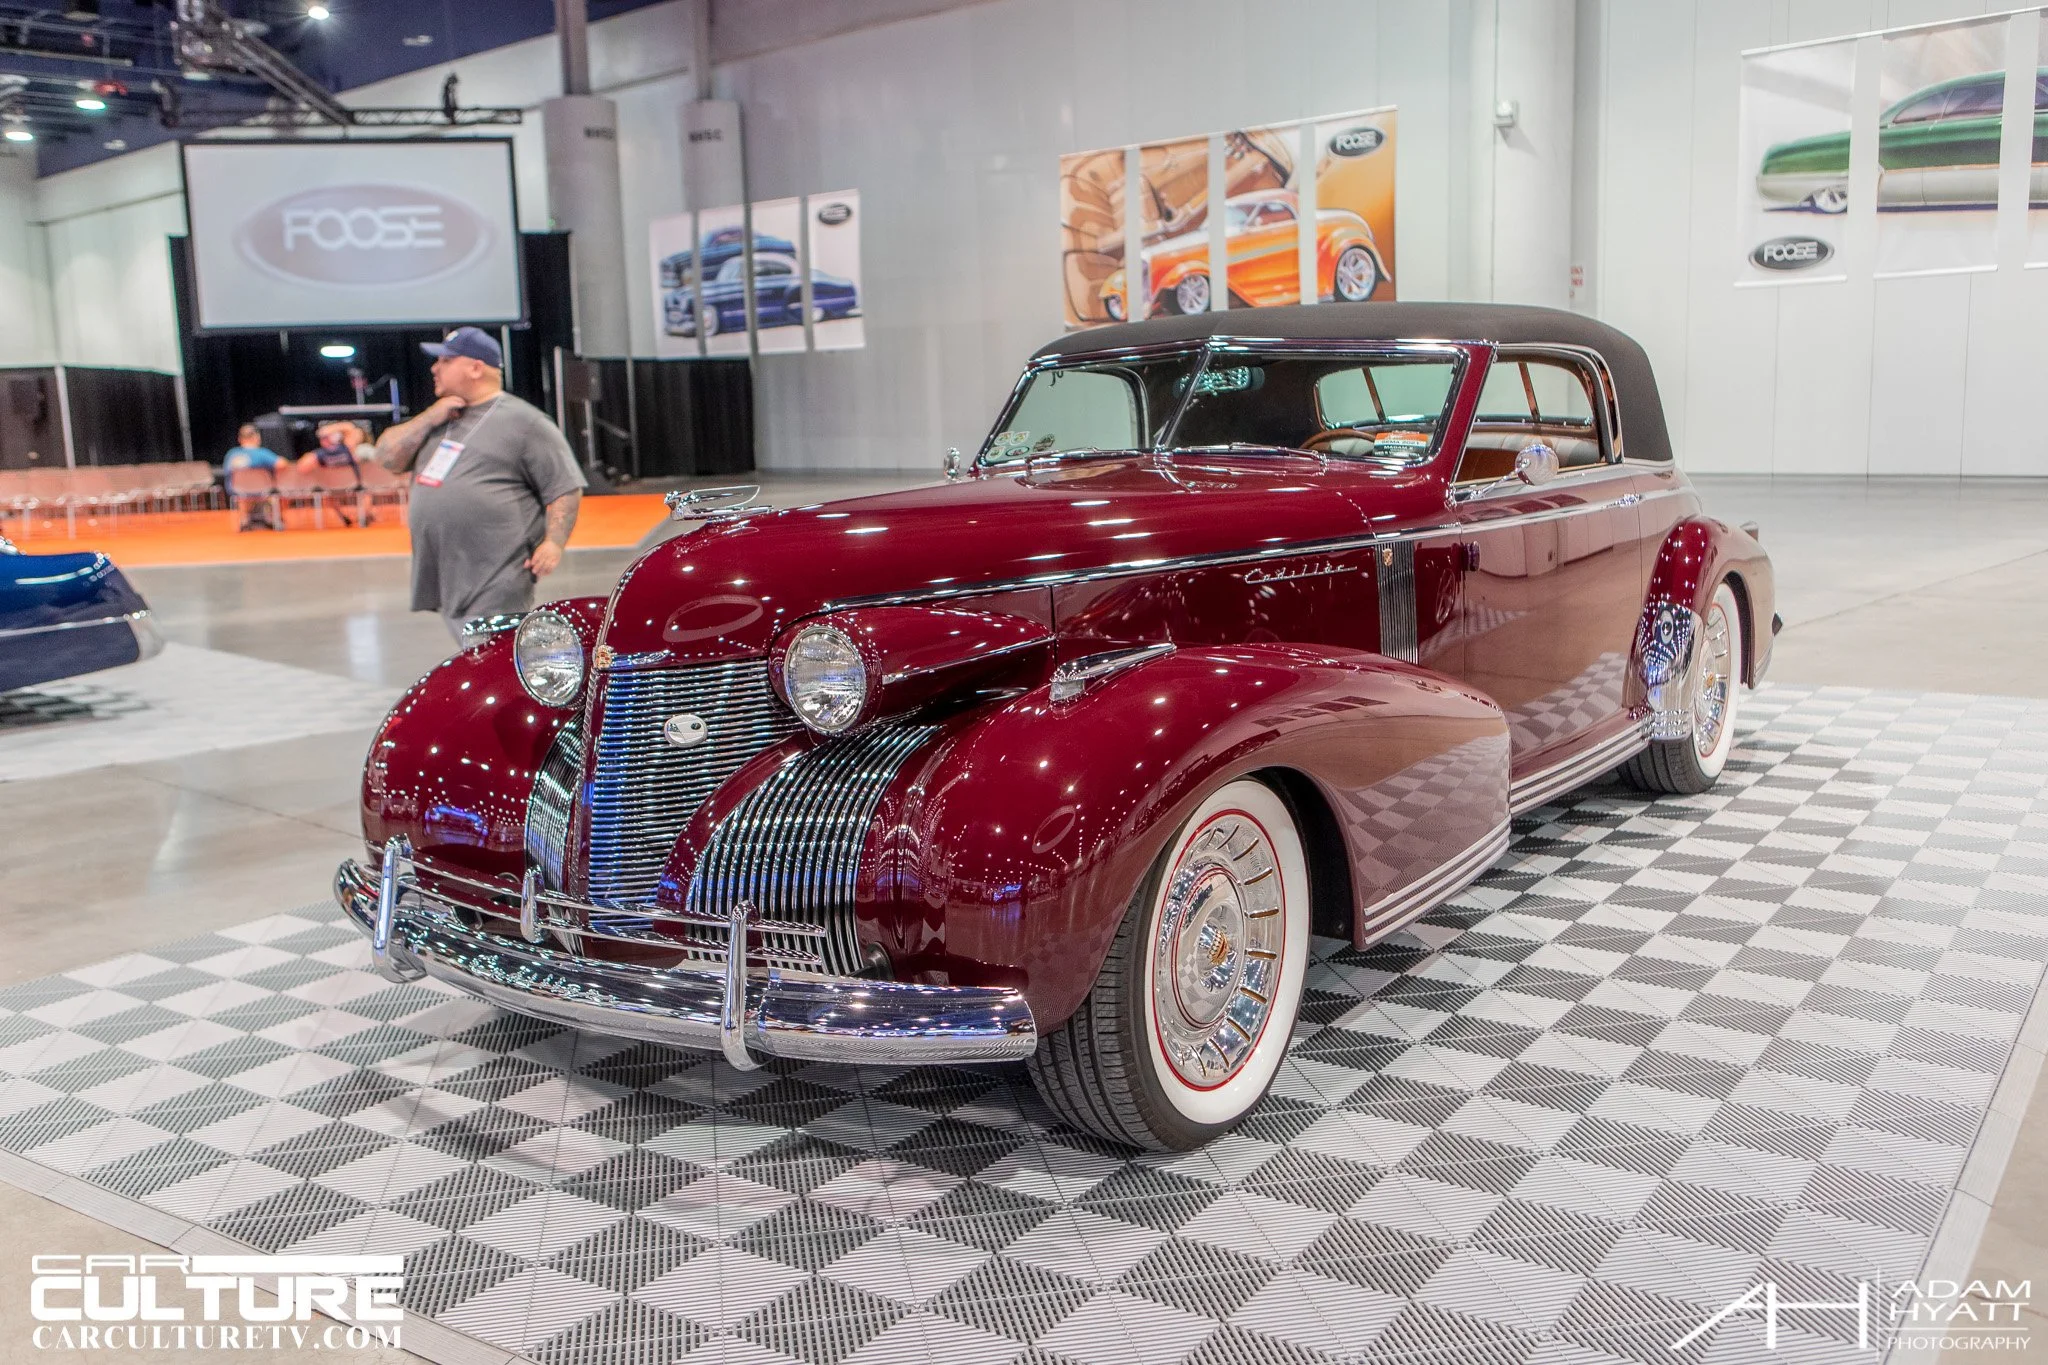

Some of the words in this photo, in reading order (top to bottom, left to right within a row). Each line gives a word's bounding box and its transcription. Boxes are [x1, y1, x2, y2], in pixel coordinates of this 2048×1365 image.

[283, 205, 444, 251] FOOSE
[1764, 242, 1818, 262] FOOSE
[1244, 561, 1358, 585] Cadillac
